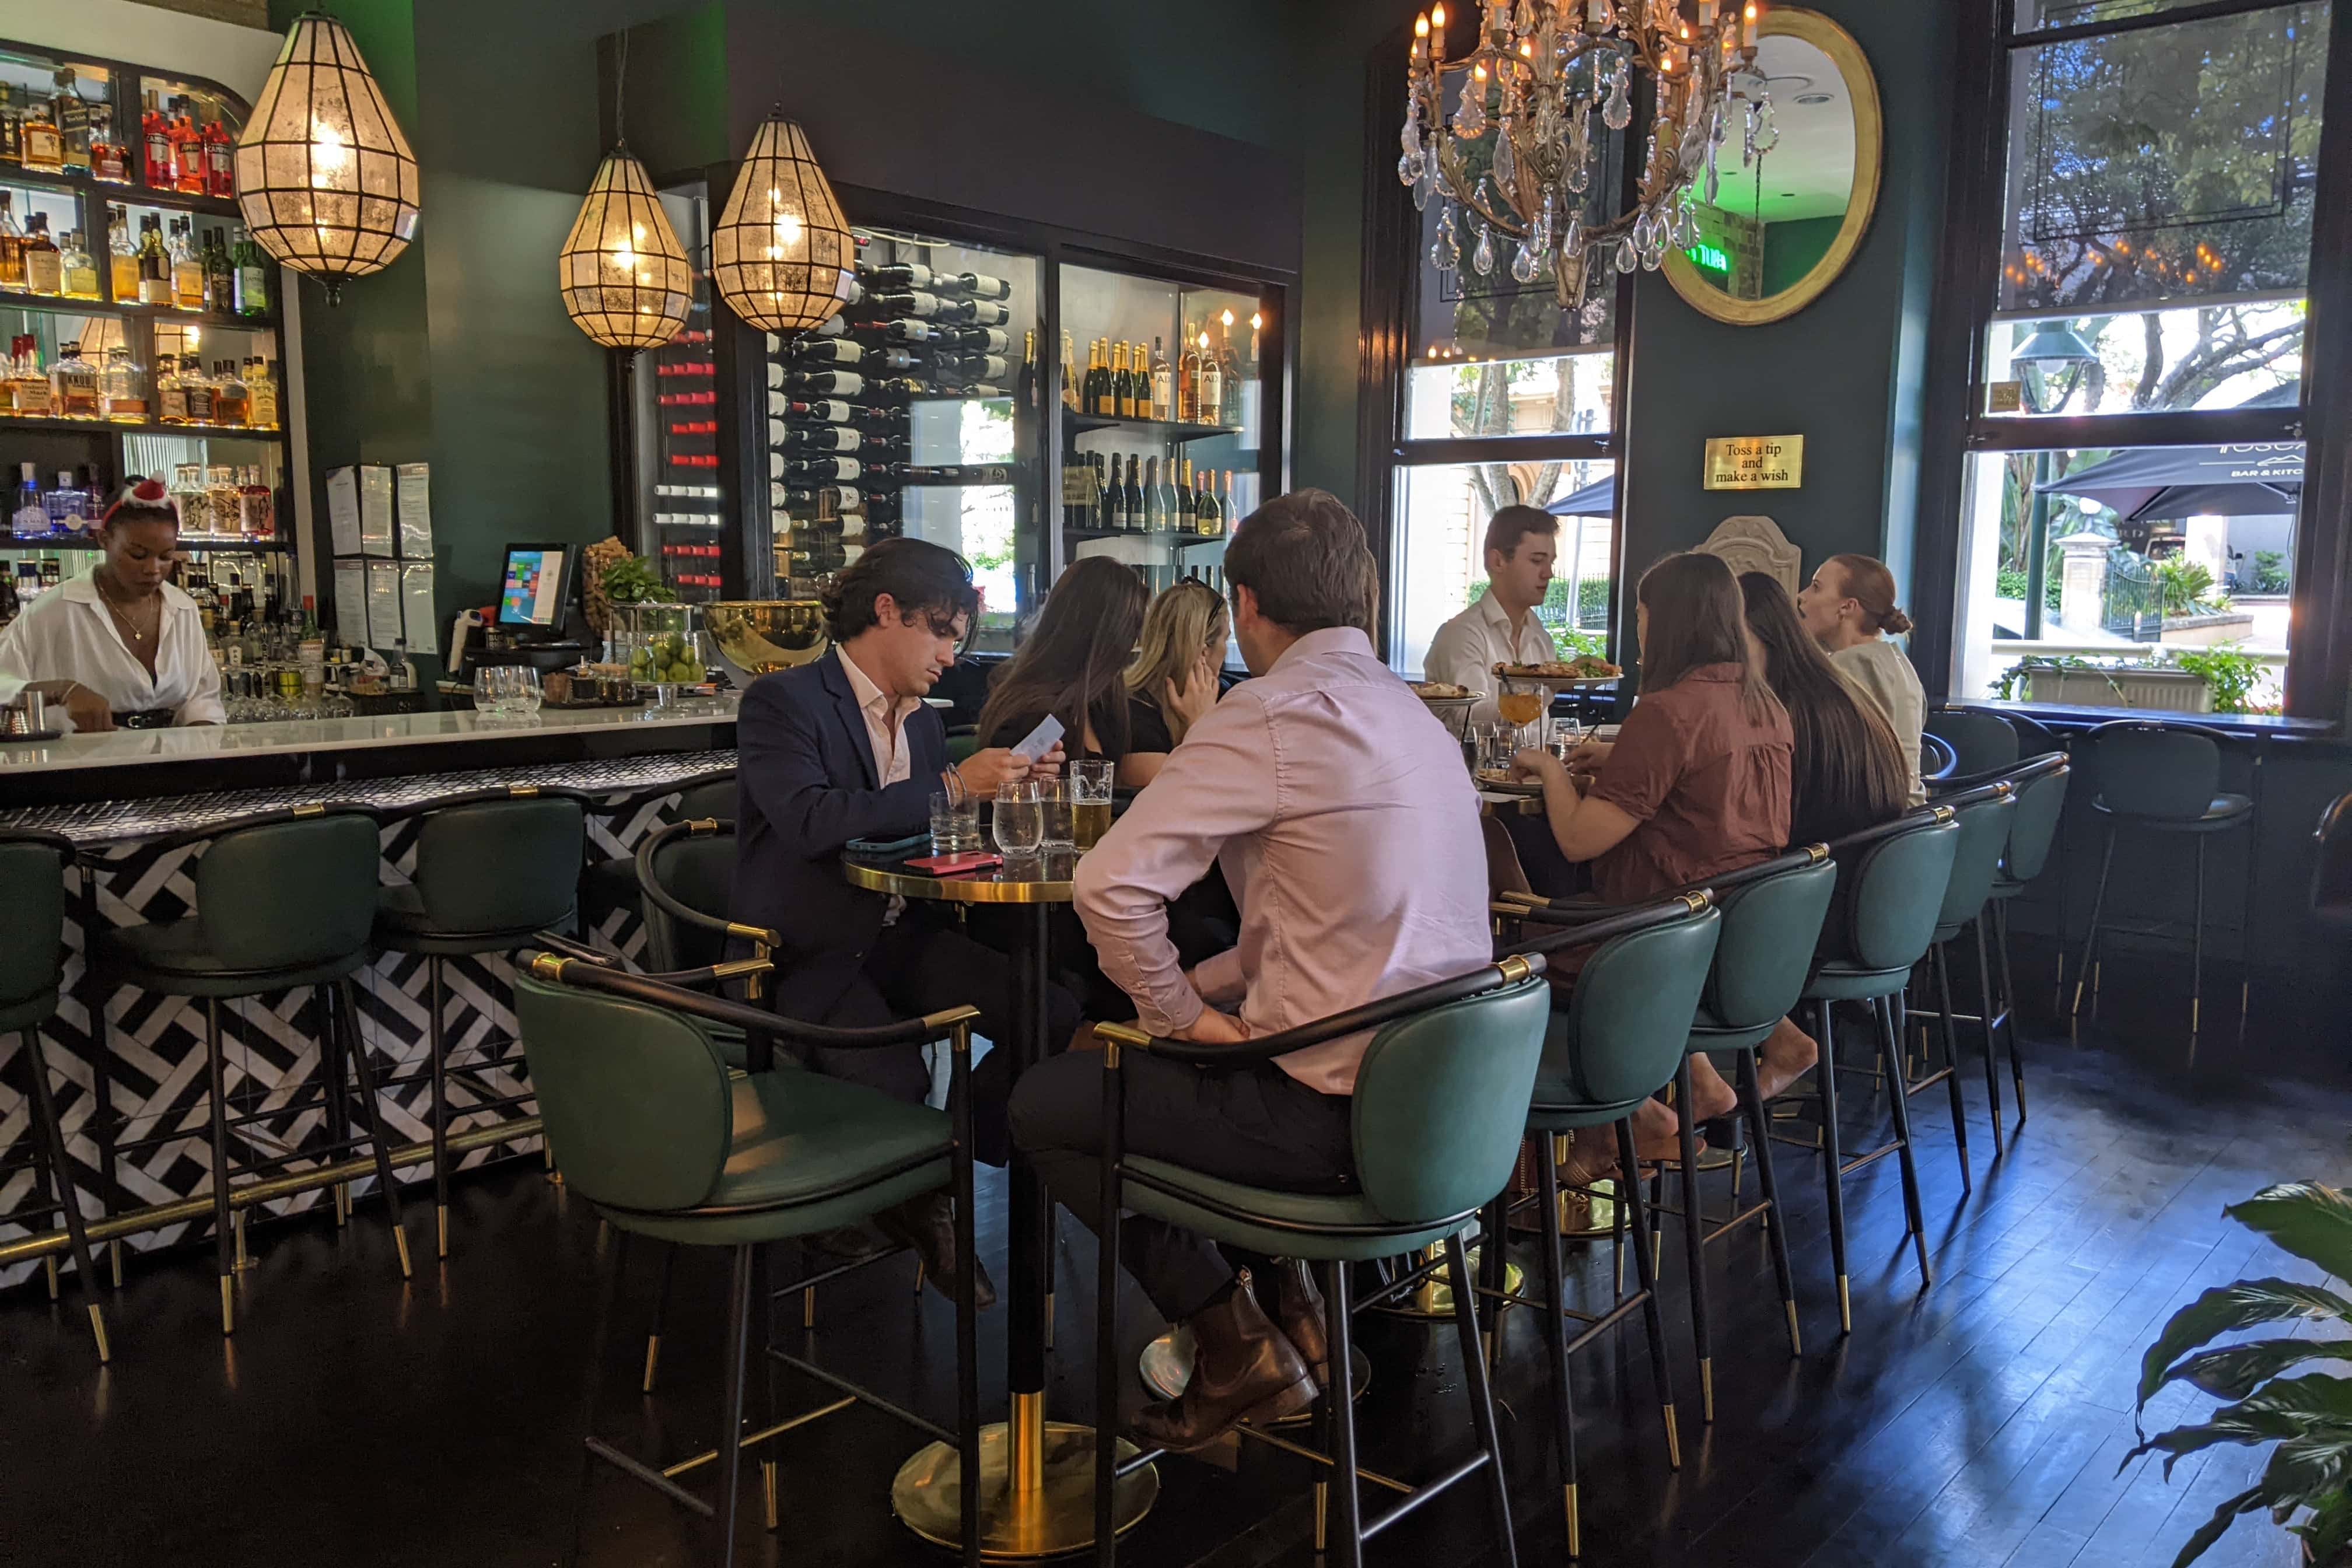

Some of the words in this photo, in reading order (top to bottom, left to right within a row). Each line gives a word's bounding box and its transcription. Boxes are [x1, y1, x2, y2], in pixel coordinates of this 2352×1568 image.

[1726, 444, 1752, 456] Toss
[1766, 442, 1782, 456] tip
[1742, 456, 1763, 468] and
[1716, 471, 1747, 482] make
[1760, 469, 1788, 481] wish
